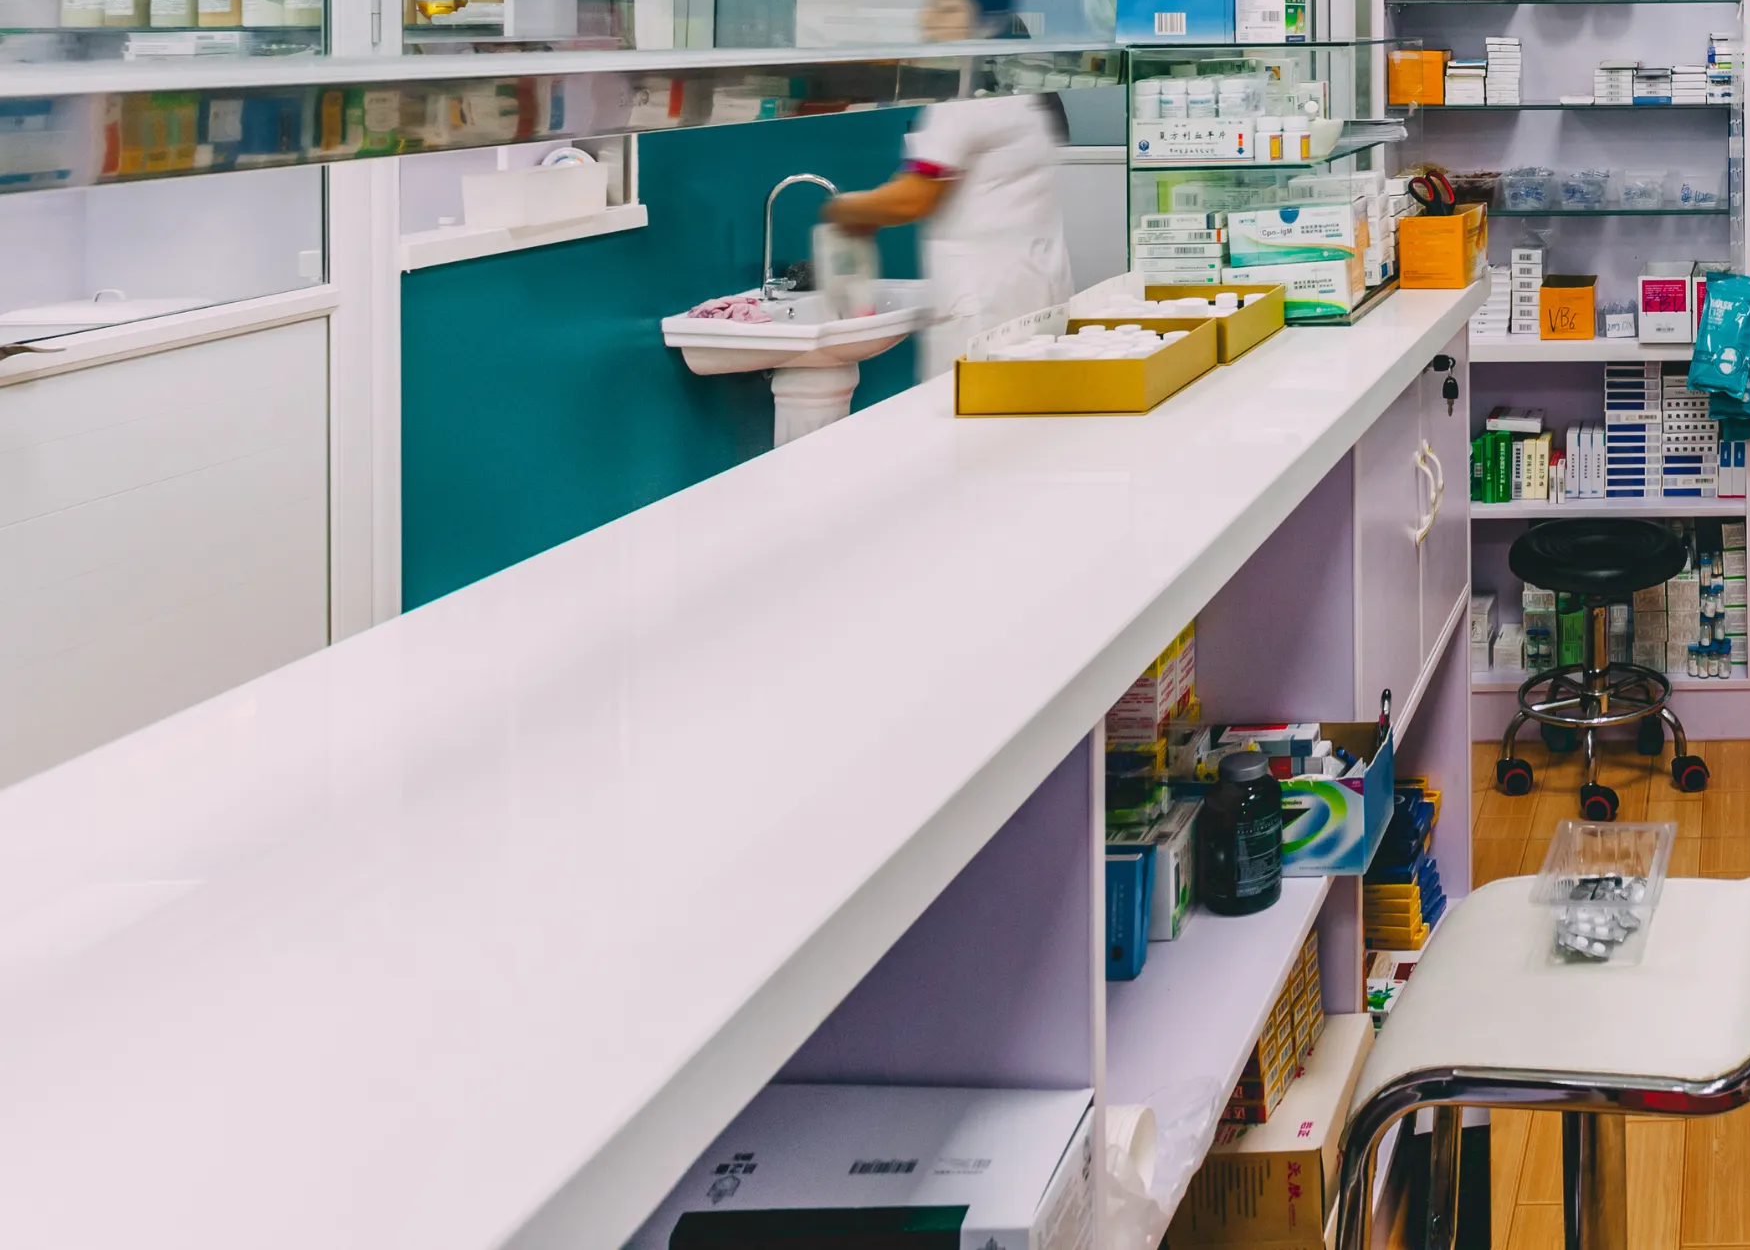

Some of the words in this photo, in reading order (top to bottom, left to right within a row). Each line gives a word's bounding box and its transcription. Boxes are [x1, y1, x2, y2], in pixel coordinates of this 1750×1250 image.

[1261, 227, 1294, 238] Cpn-IgM
[1710, 298, 1733, 309] MASK
[1549, 306, 1576, 332] VB6
